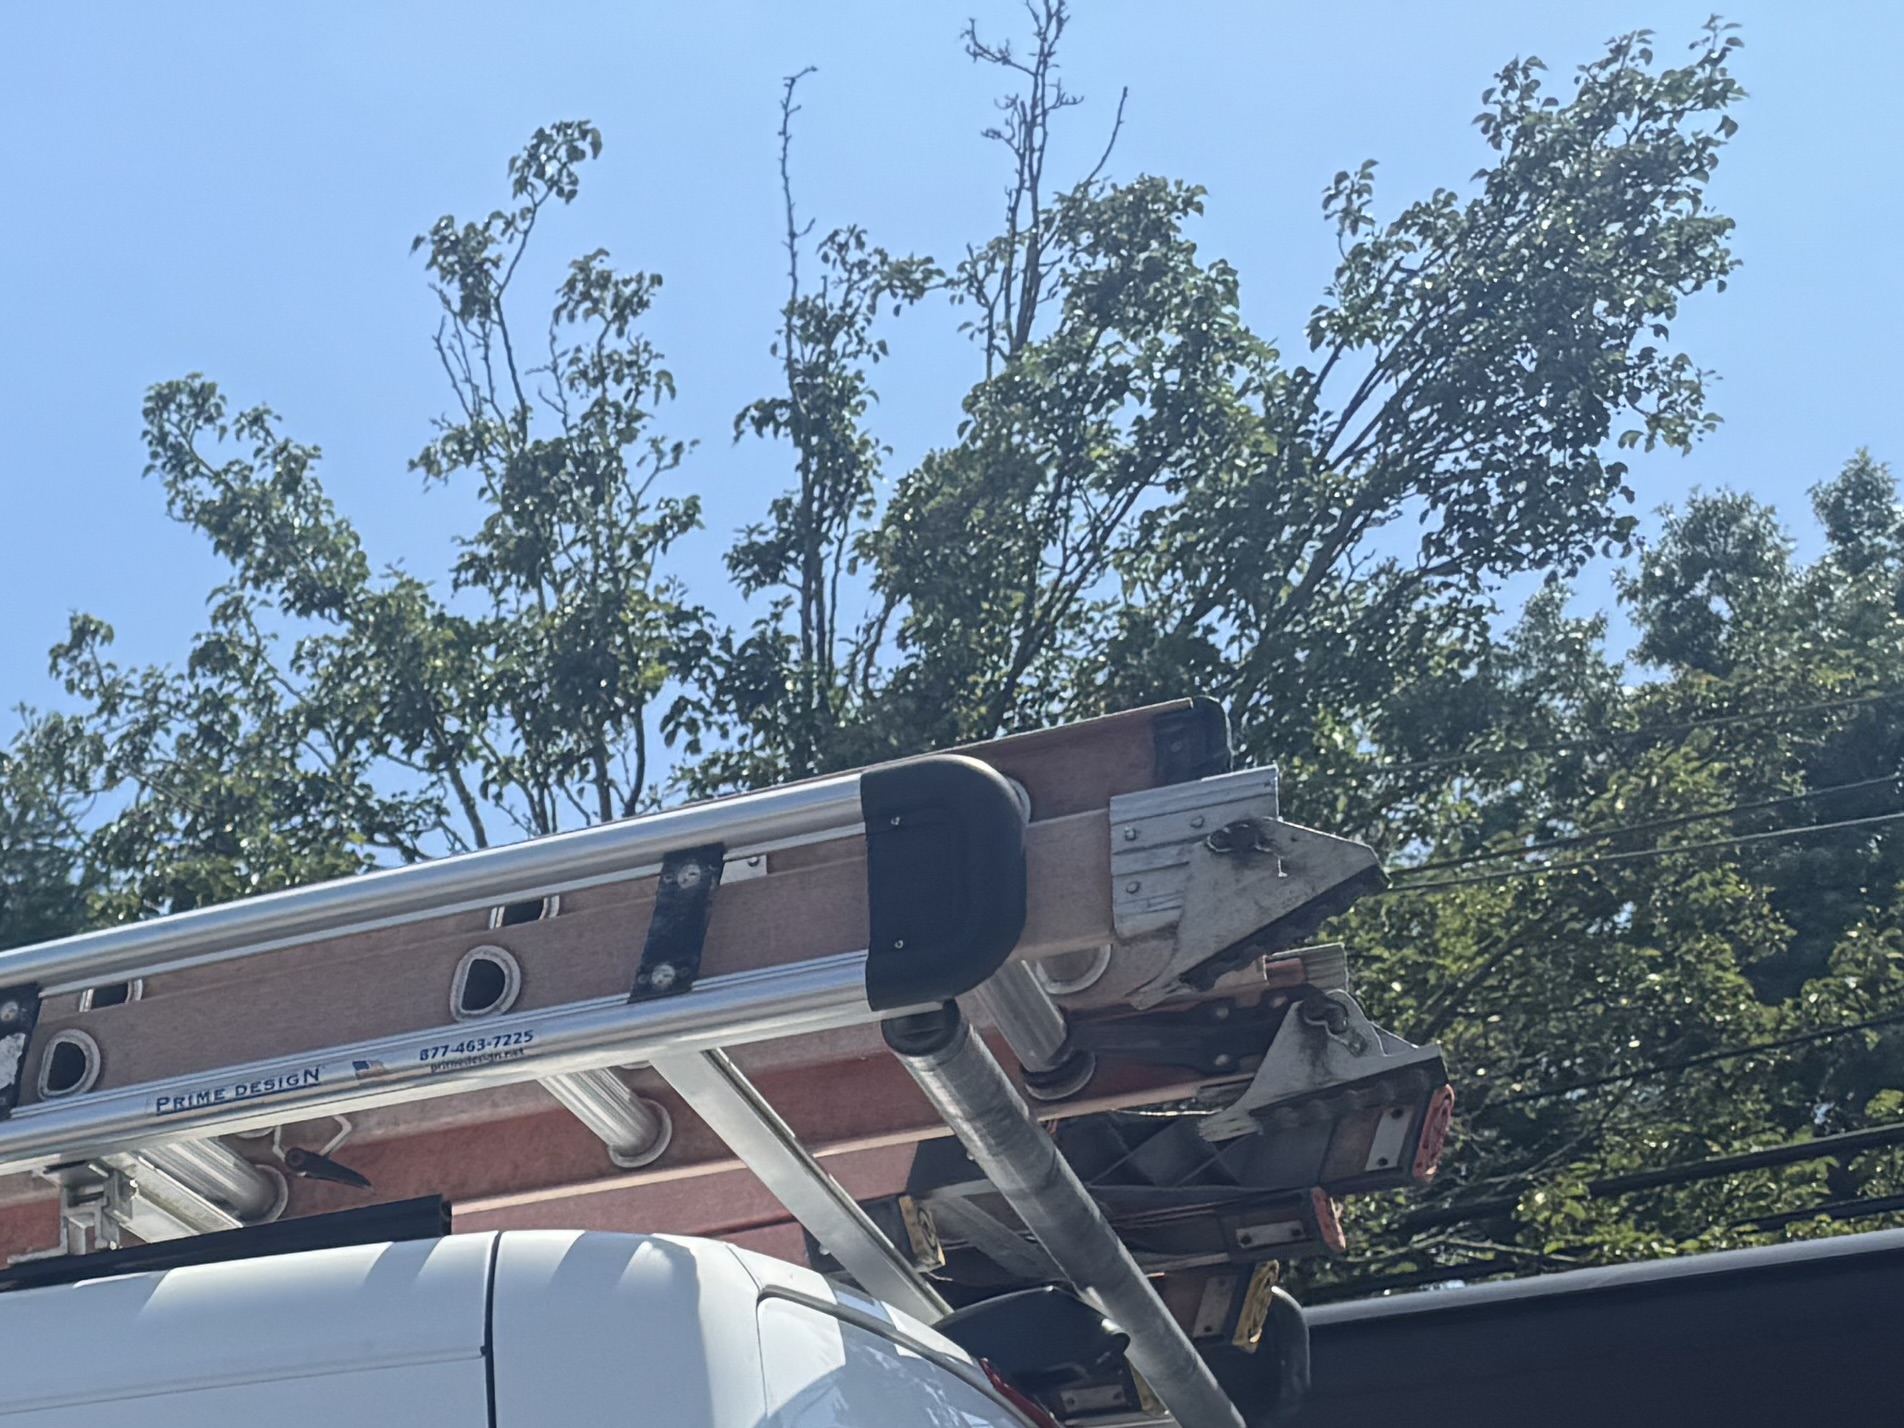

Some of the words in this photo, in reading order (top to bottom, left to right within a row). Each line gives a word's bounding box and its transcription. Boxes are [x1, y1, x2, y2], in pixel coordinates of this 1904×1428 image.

[419, 1029, 534, 1062] 877-463-7225
[155, 1086, 226, 1113] PRIME
[234, 1067, 321, 1097] DESIGN
